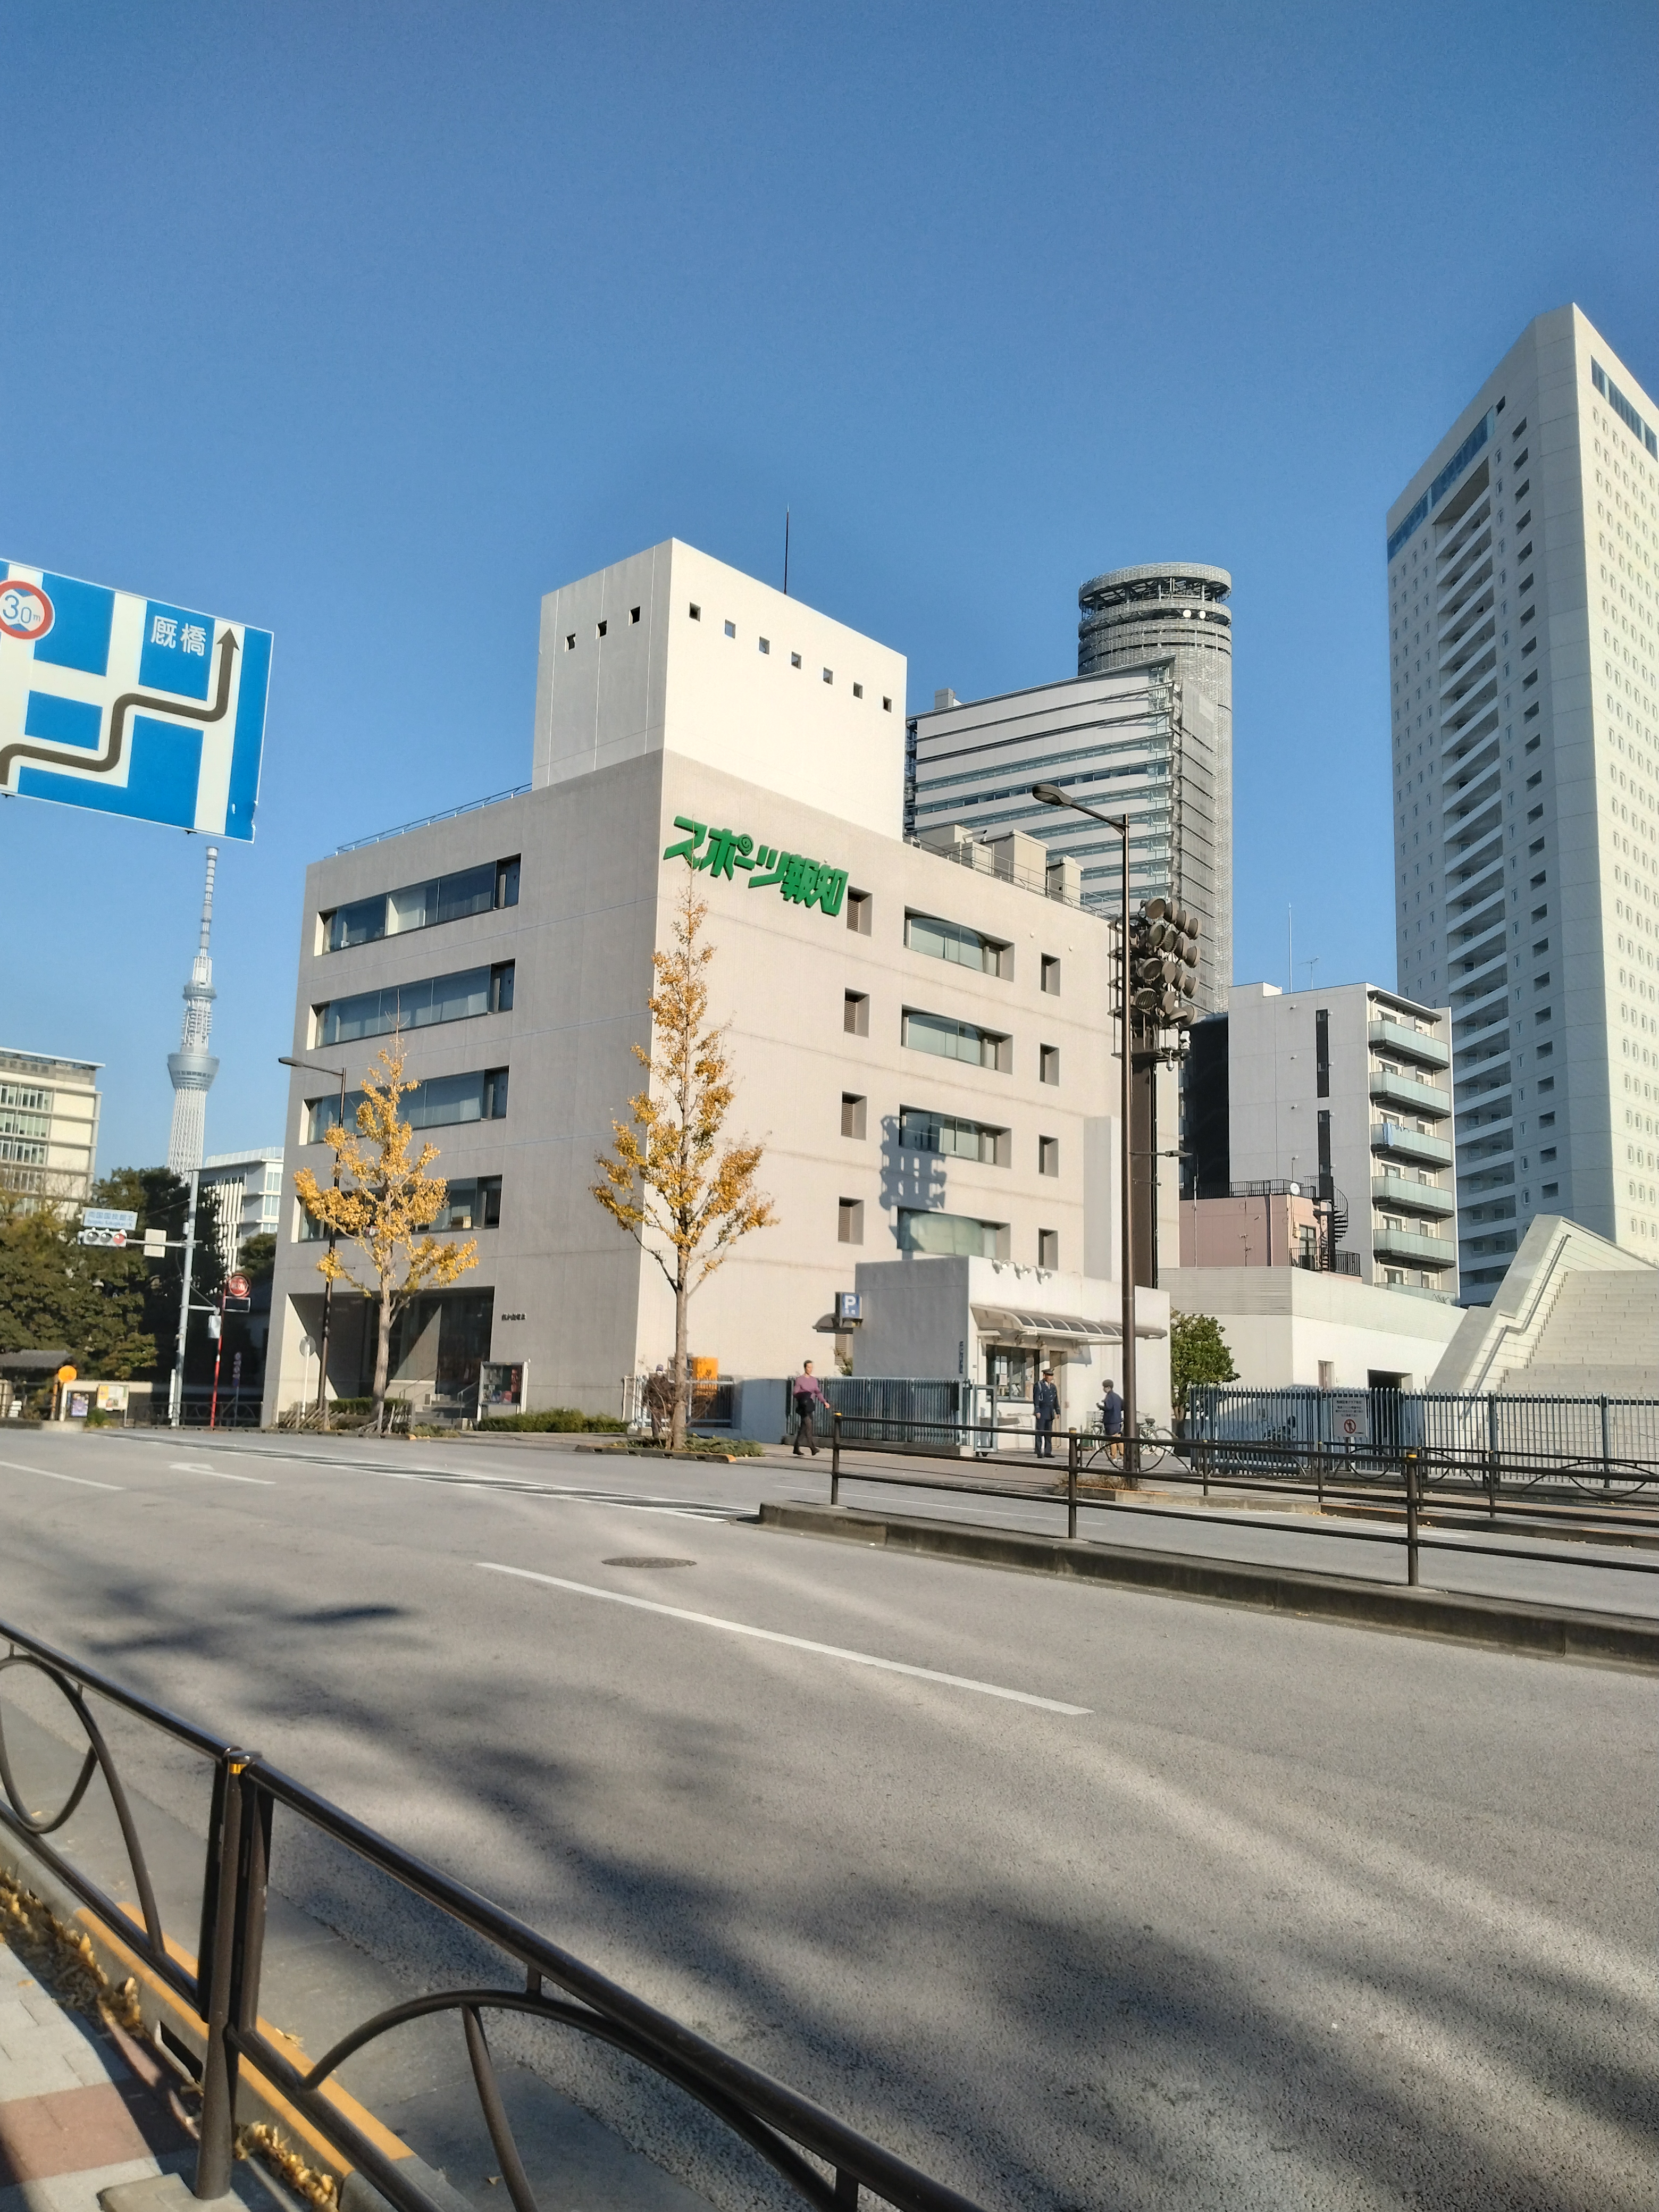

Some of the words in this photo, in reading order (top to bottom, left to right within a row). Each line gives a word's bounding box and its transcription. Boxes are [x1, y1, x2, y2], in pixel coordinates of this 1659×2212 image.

[150, 615, 207, 657] 厩橋
[663, 815, 849, 917] スポーツ報知
[844, 1295, 856, 1309] P
